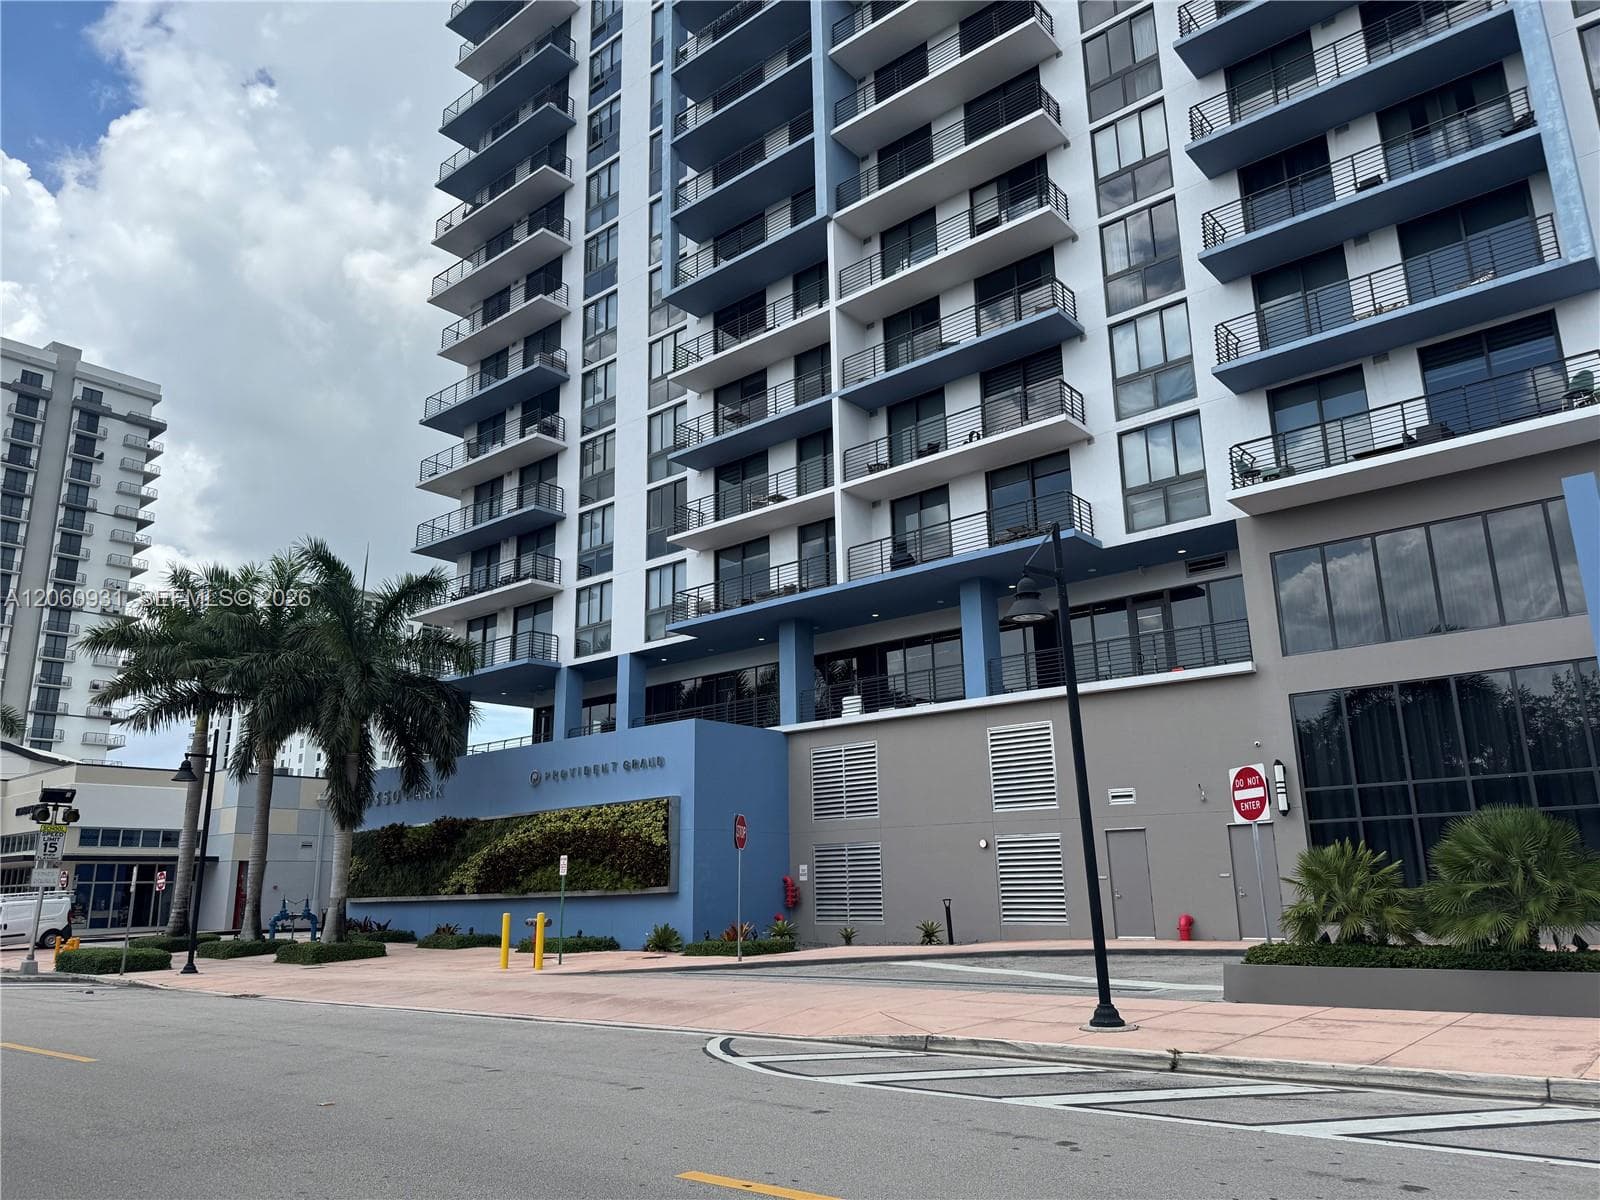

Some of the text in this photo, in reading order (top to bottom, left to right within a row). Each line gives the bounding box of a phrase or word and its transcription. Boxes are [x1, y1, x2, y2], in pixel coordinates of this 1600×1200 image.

[544, 756, 666, 781] PROVIDENT GRAND
[1235, 776, 1260, 788] DO NOT
[1240, 800, 1261, 811] ENTER
[736, 825, 746, 838] STOP
[43, 842, 58, 853] 15
